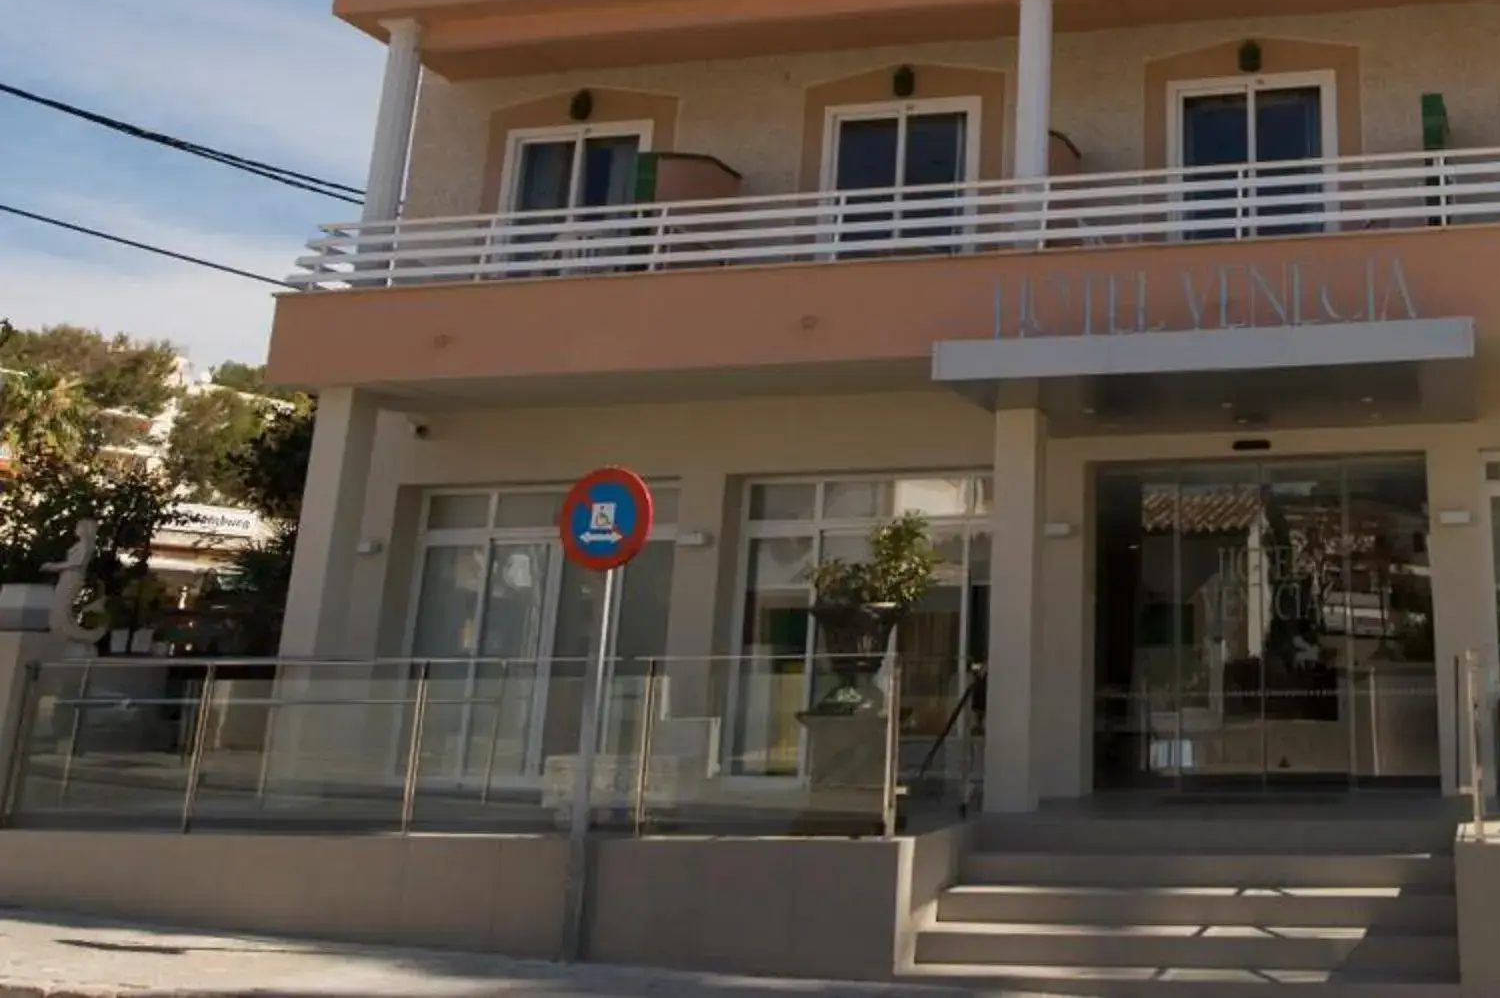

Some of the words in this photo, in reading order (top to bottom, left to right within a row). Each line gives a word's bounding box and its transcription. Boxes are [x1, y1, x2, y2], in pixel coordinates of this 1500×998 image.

[993, 268, 1166, 340] HOTEL
[1180, 256, 1416, 330] VENECIA
[1217, 545, 1309, 581] HOEL
[1203, 583, 1322, 624] VENCIA
